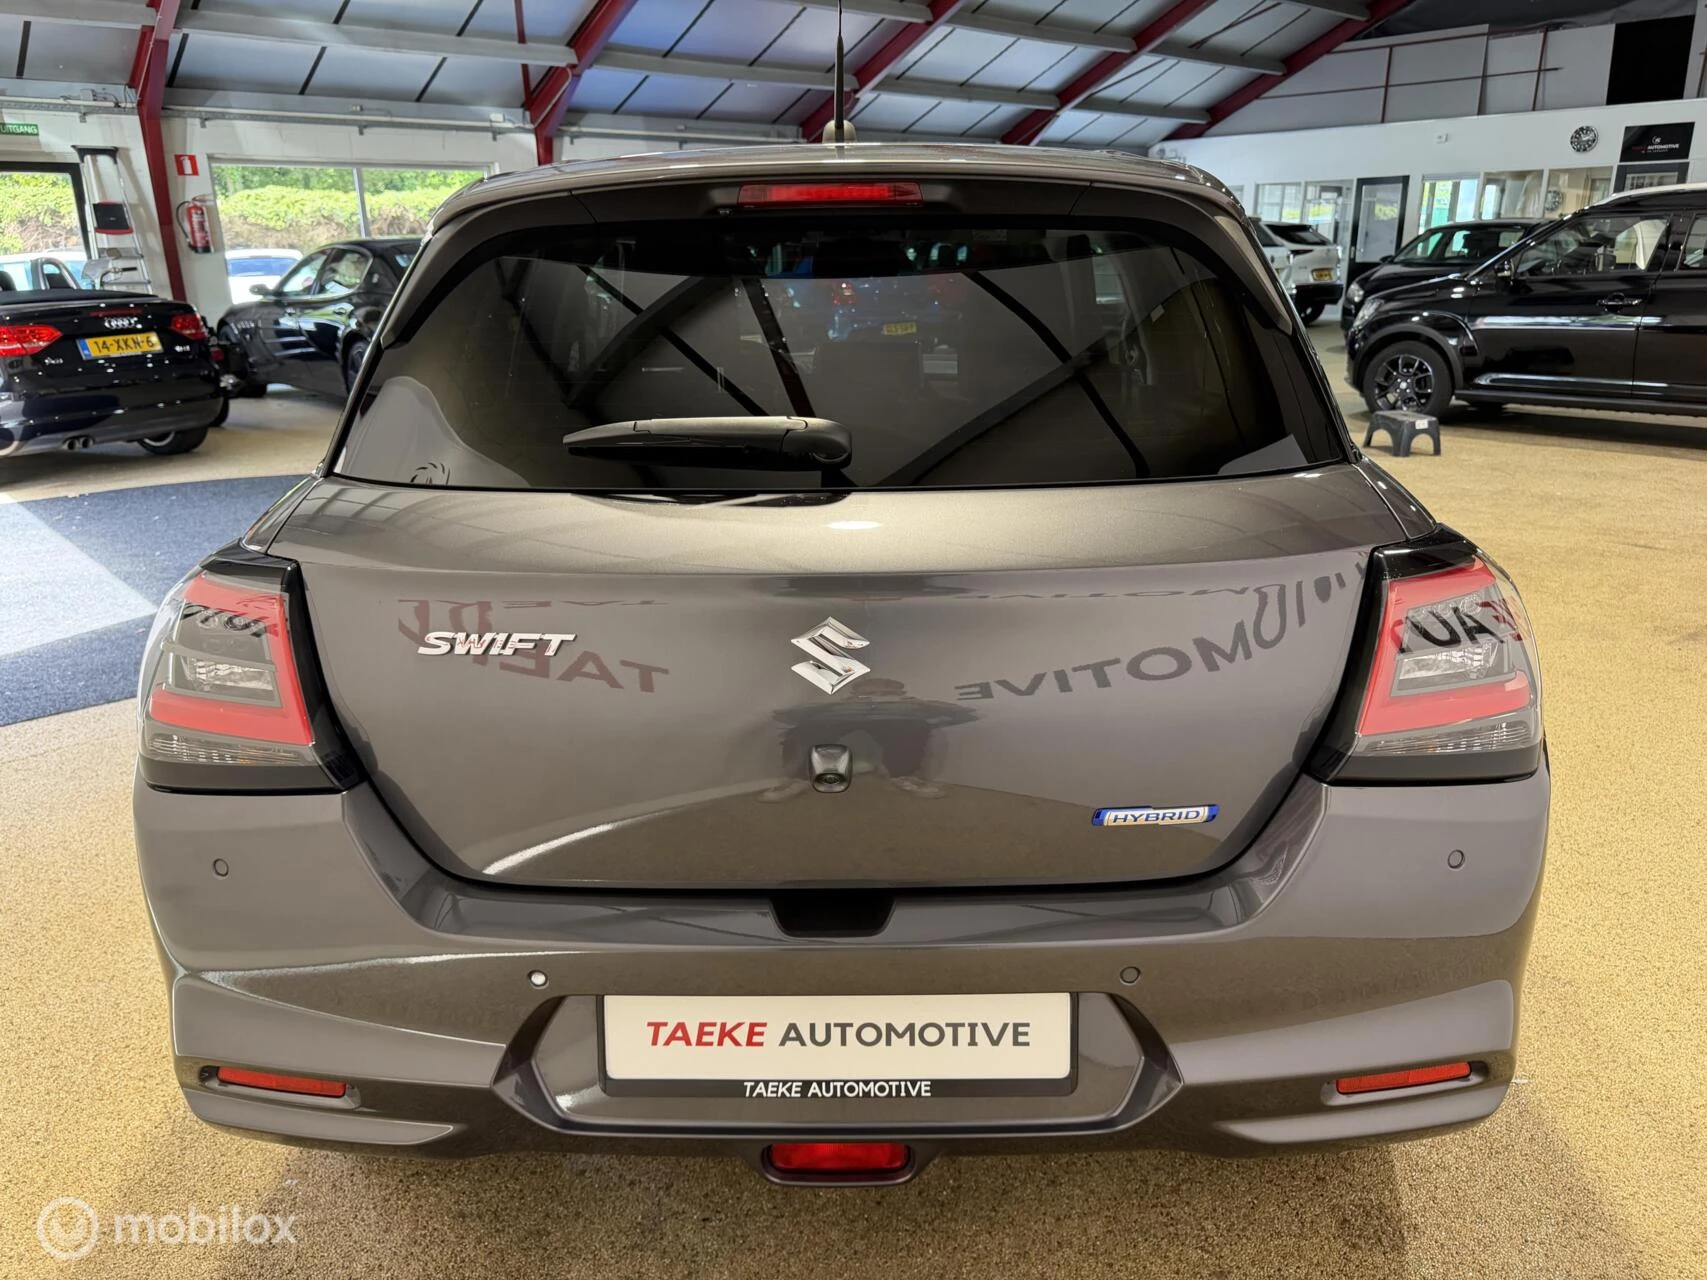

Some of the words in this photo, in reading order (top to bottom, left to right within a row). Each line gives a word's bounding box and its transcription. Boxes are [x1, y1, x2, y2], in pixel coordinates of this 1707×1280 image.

[417, 631, 577, 657] SWIFT
[1113, 810, 1201, 823] HYBRID
[646, 1021, 768, 1047] TAEKE
[778, 1022, 1031, 1047] AUTOMOTIVE
[743, 1081, 802, 1098] TAEKE
[807, 1081, 932, 1097] AUTOMOTIVE
